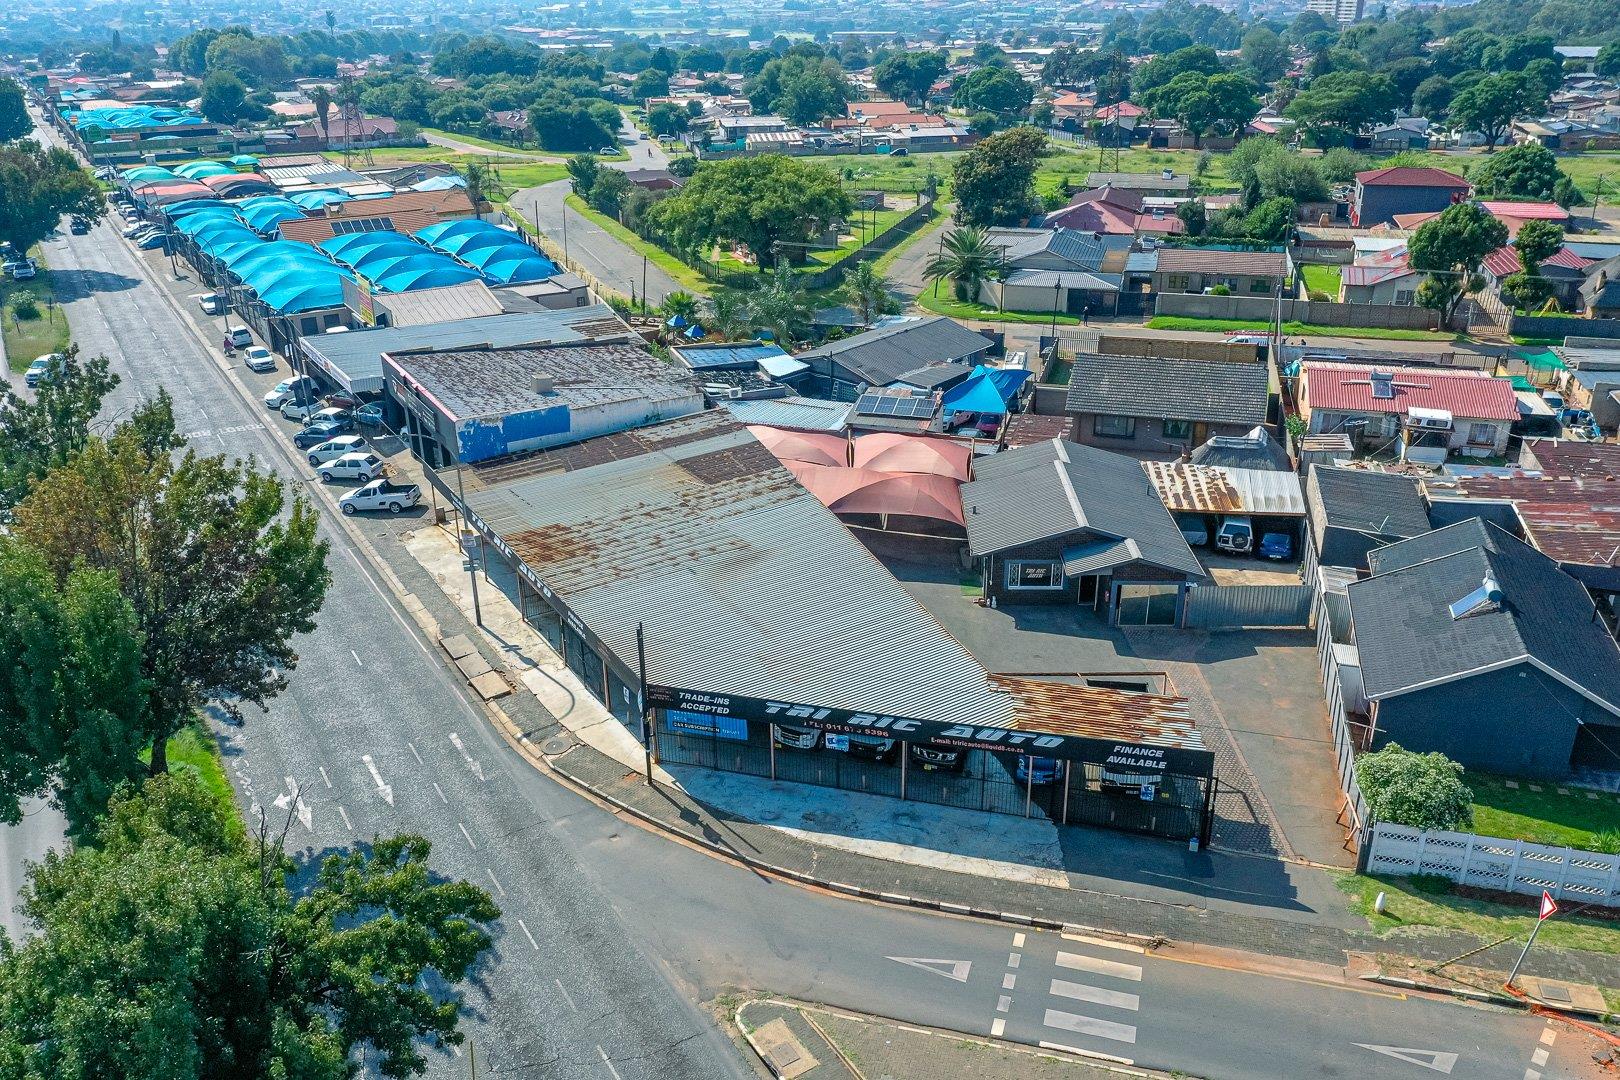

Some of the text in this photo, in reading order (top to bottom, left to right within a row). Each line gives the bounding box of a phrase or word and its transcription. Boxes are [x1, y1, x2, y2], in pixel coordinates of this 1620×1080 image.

[471, 512, 552, 598] TRI RIC AUTO
[679, 692, 730, 705] TRADE-INS
[680, 702, 730, 714] ACCEPTED
[765, 701, 1065, 748] TRI RIC AUTO
[826, 724, 842, 732] 011
[864, 729, 889, 738] 5396
[1113, 745, 1165, 758] FINANCE
[1106, 755, 1168, 769] AVAILABLE
